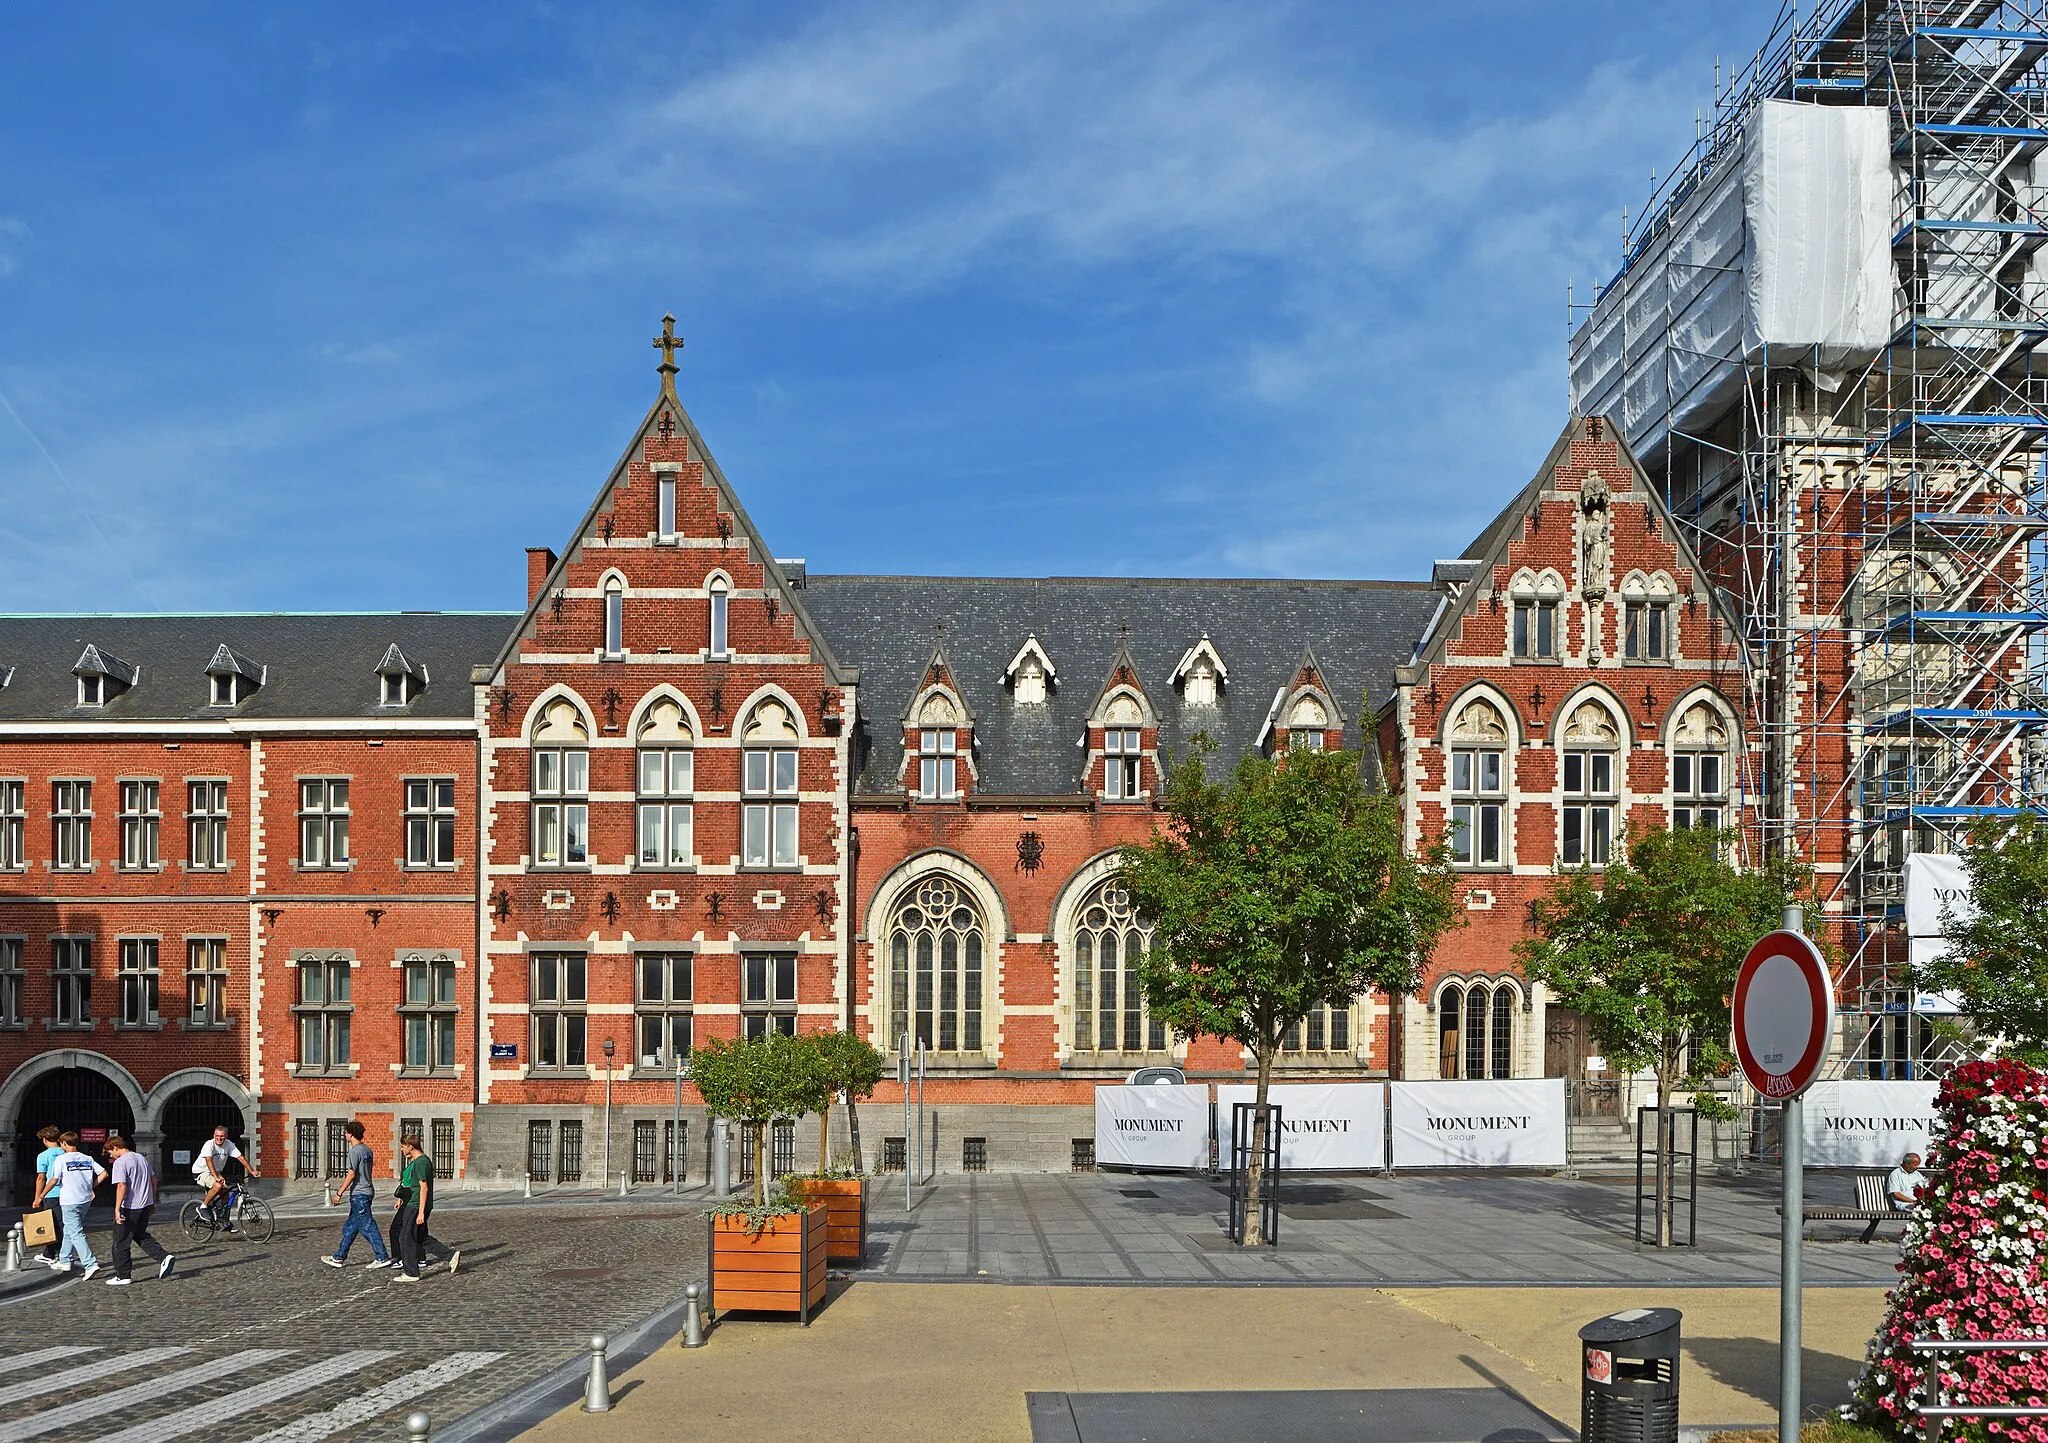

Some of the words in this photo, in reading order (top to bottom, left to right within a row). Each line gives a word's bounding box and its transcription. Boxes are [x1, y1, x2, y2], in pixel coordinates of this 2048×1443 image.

[1891, 809, 1906, 818] MSC
[1890, 1002, 1905, 1010] MSC
[1114, 1119, 1183, 1131] MONUMENT
[1427, 1116, 1531, 1130] MONUMENT
[1846, 1134, 1877, 1142] GROUP
